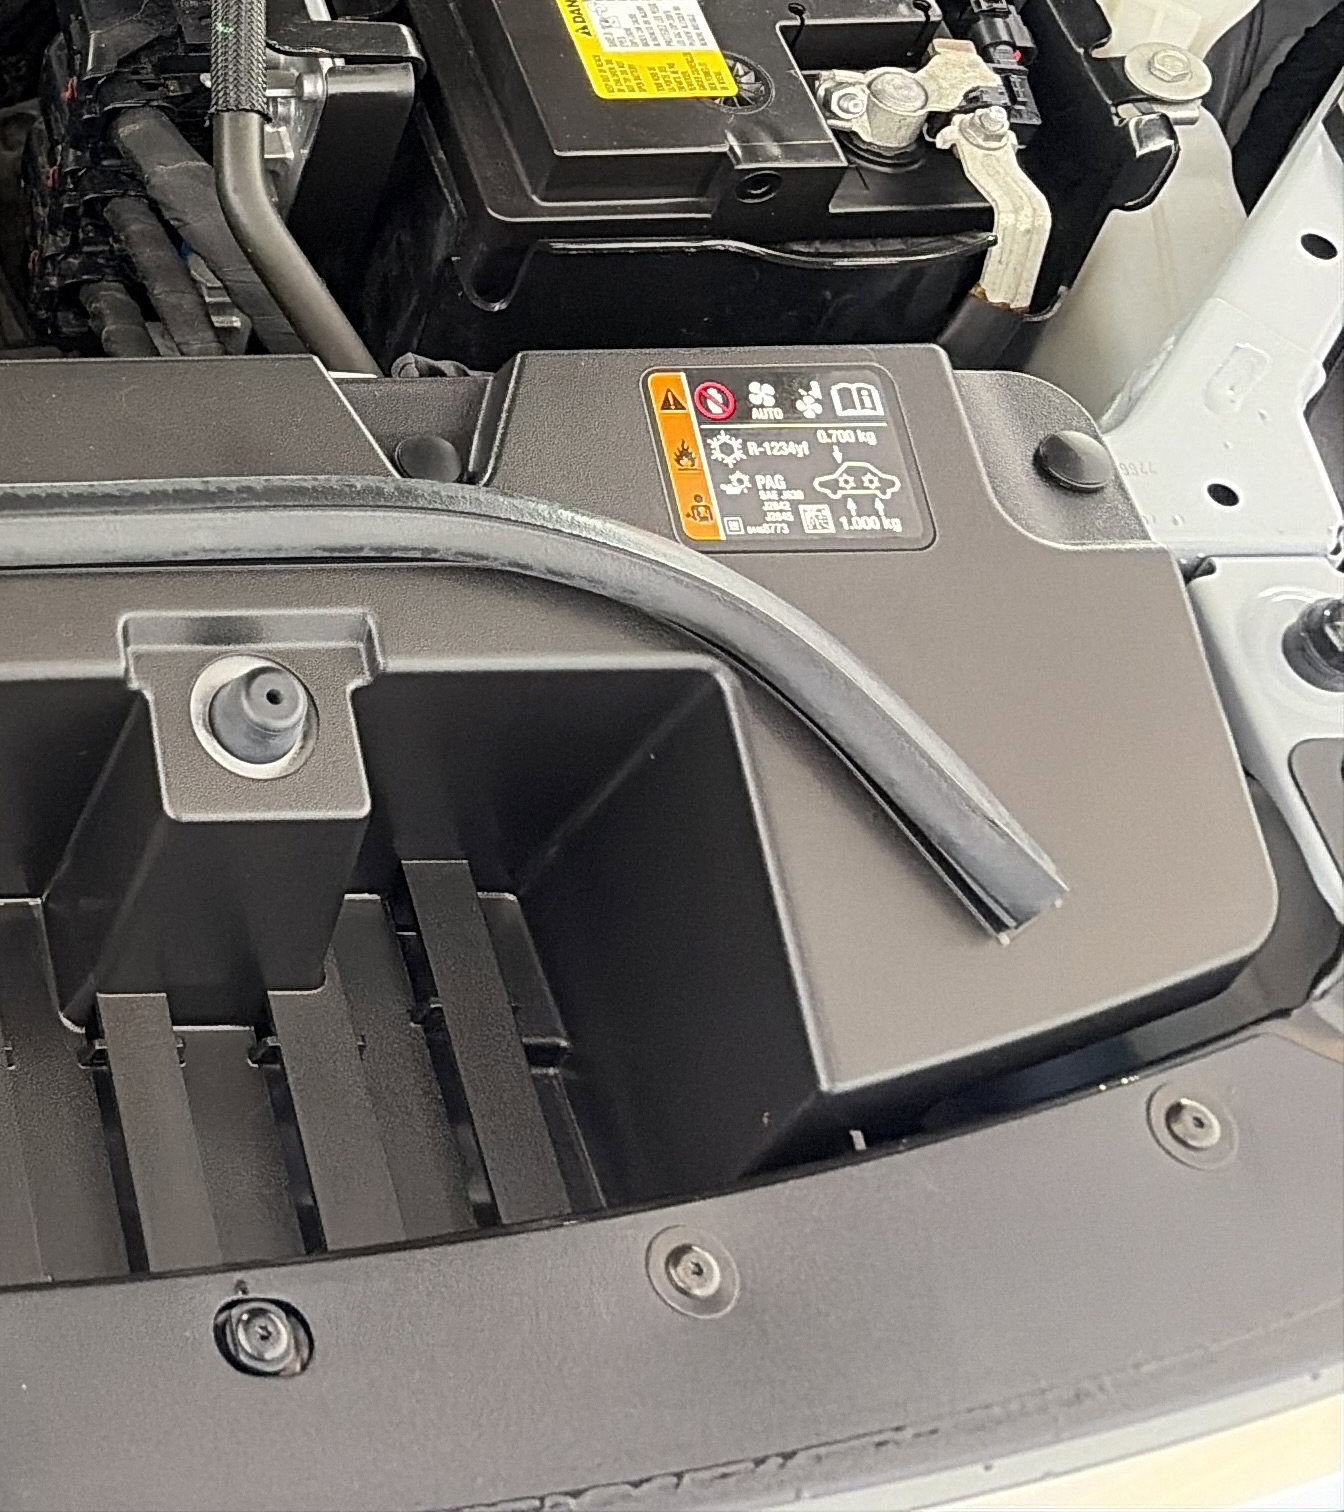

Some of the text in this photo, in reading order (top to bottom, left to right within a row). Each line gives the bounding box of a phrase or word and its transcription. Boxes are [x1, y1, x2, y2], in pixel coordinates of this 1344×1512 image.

[751, 407, 784, 420] AUTO
[816, 429, 878, 446] 0.700 kg
[746, 441, 810, 458] R-1234yf
[754, 474, 787, 490] PAG
[838, 516, 903, 533] 1.000 kg
